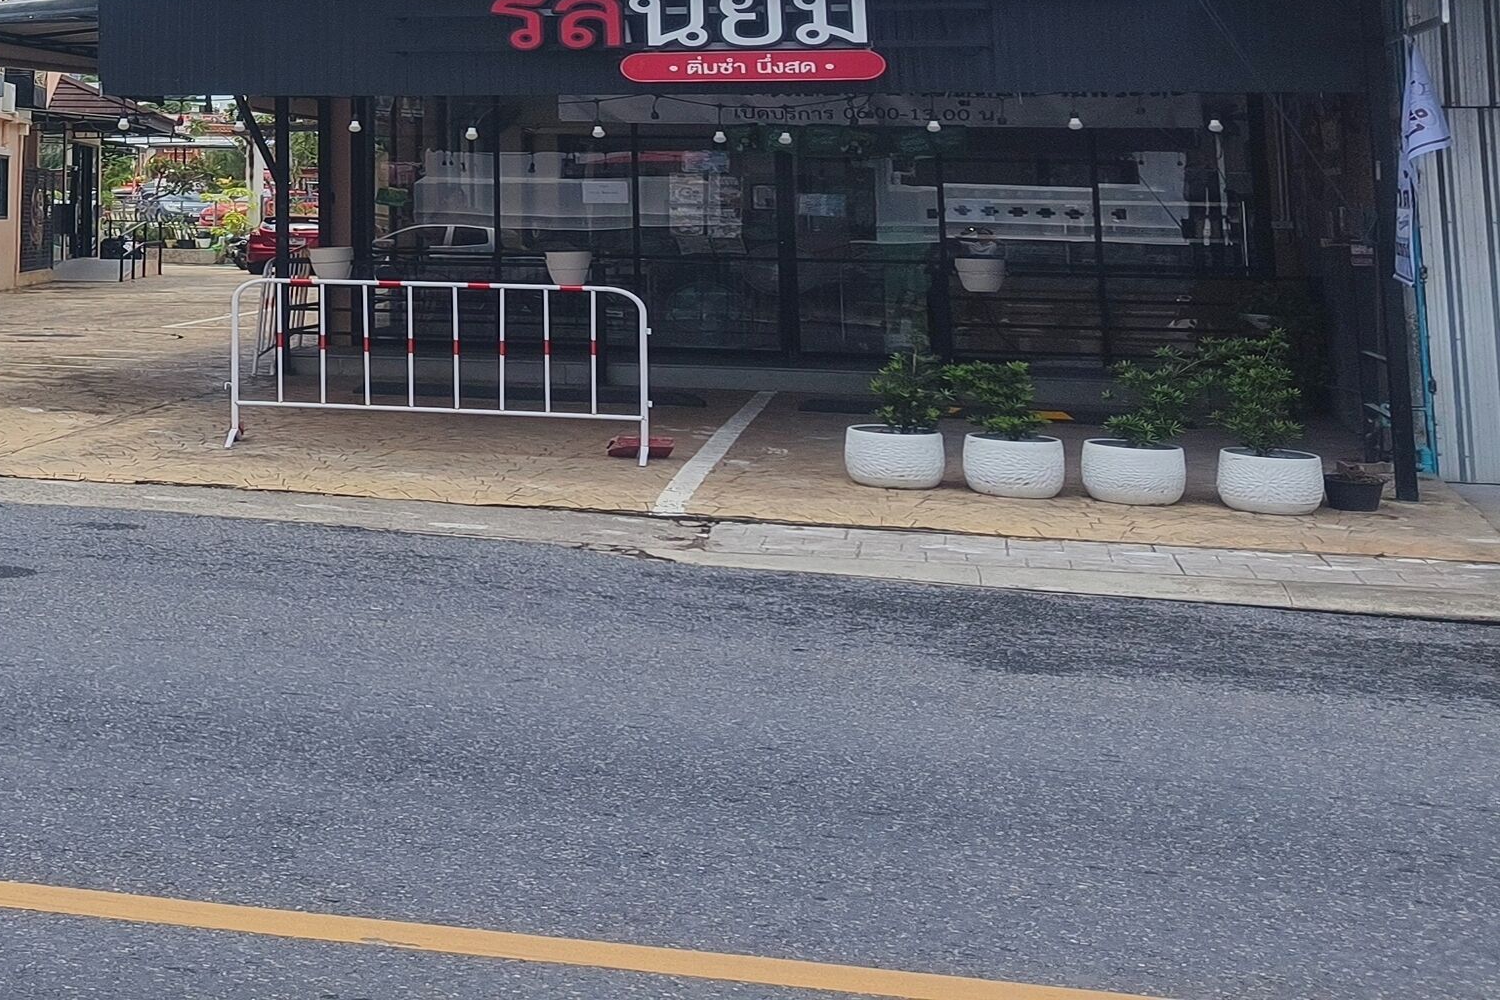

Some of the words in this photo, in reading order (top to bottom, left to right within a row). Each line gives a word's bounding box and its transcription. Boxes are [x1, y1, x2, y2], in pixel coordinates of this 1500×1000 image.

[686, 55, 746, 75] ติ่มซำ
[757, 53, 816, 73] นึ่งสด
